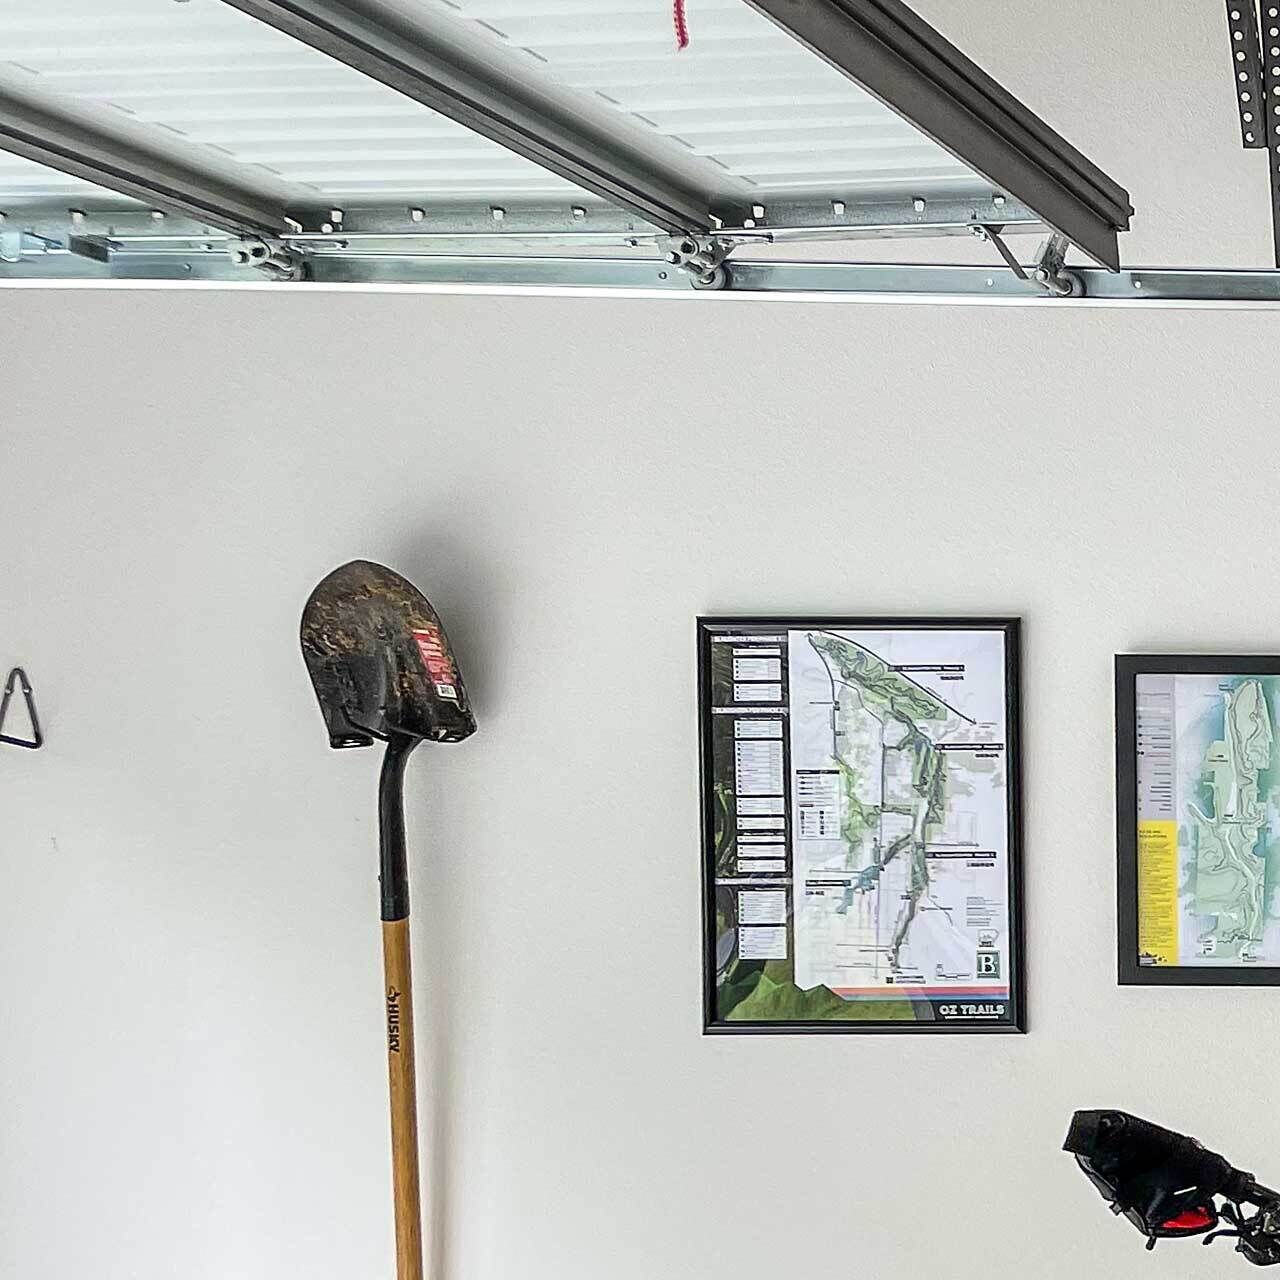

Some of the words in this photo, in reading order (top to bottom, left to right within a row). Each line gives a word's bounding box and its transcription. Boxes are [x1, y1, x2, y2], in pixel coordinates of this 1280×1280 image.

[939, 1004, 958, 1015] OZ
[960, 1004, 1005, 1015] TRAILS
[388, 1004, 400, 1053] HUSKY
